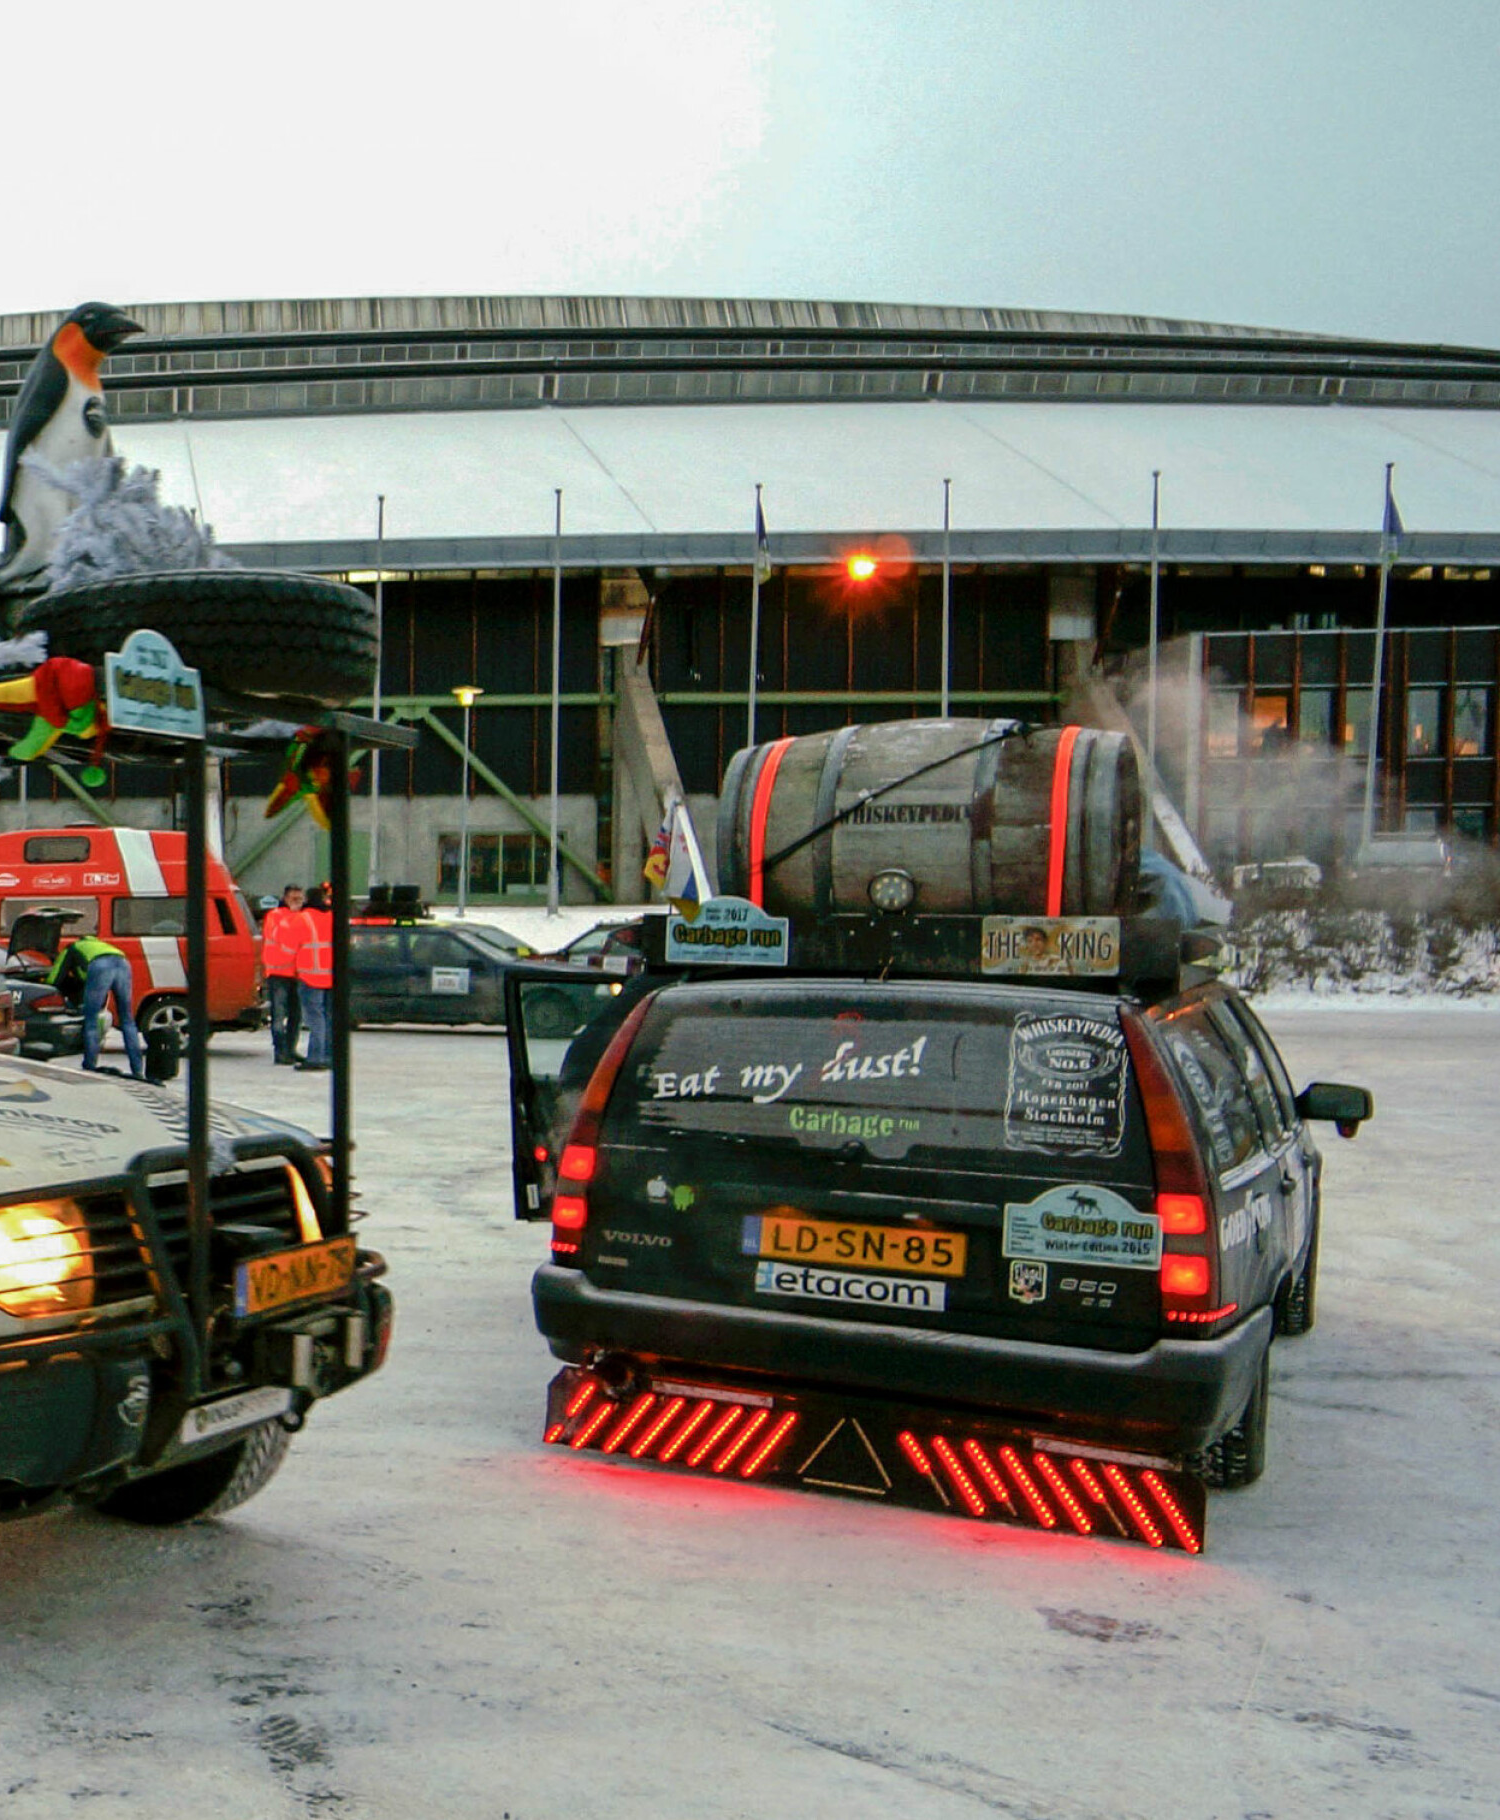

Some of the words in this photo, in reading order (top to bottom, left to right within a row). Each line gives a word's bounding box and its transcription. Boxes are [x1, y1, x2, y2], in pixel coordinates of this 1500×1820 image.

[750, 928, 782, 949] run
[987, 931, 1021, 959] THE
[1060, 931, 1113, 961] KING
[1017, 1018, 1125, 1048] WHISKEYPEDIA
[653, 1064, 721, 1099] Eat
[738, 1061, 803, 1104] my
[820, 1035, 928, 1083] dust!
[1024, 1106, 1106, 1126] Stockholm
[601, 1229, 673, 1248] VOLVO
[1120, 1220, 1154, 1240] run
[771, 1223, 954, 1267] LD-SN-85
[1045, 1239, 1081, 1252] Winter
